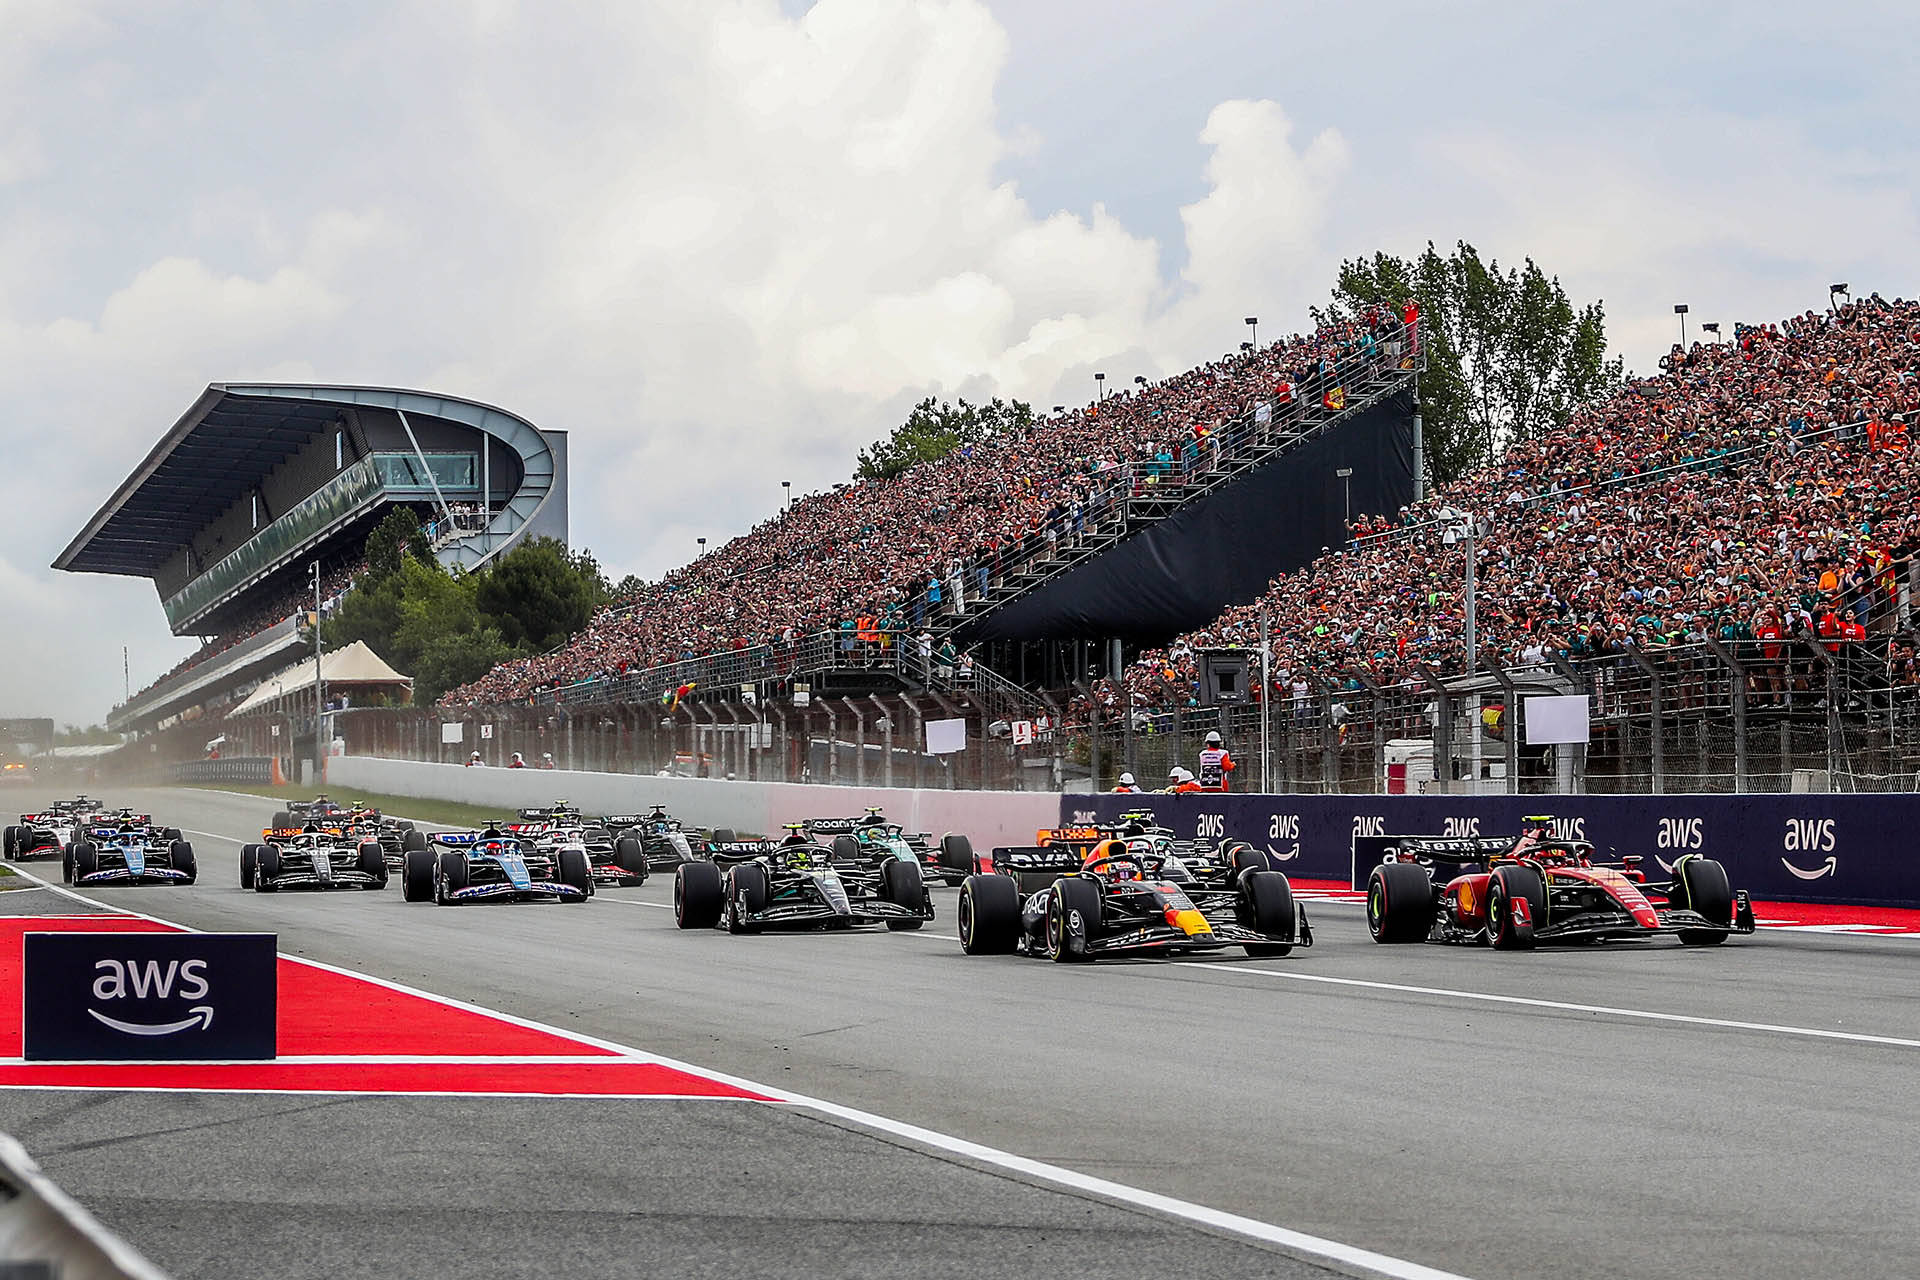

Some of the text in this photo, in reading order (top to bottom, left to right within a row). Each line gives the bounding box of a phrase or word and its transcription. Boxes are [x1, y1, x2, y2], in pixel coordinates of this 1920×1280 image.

[1196, 813, 1225, 838] aws
[1269, 814, 1300, 840] aws
[1657, 818, 1703, 849] aws
[1784, 818, 1836, 851] aws
[93, 958, 209, 1000] aws
